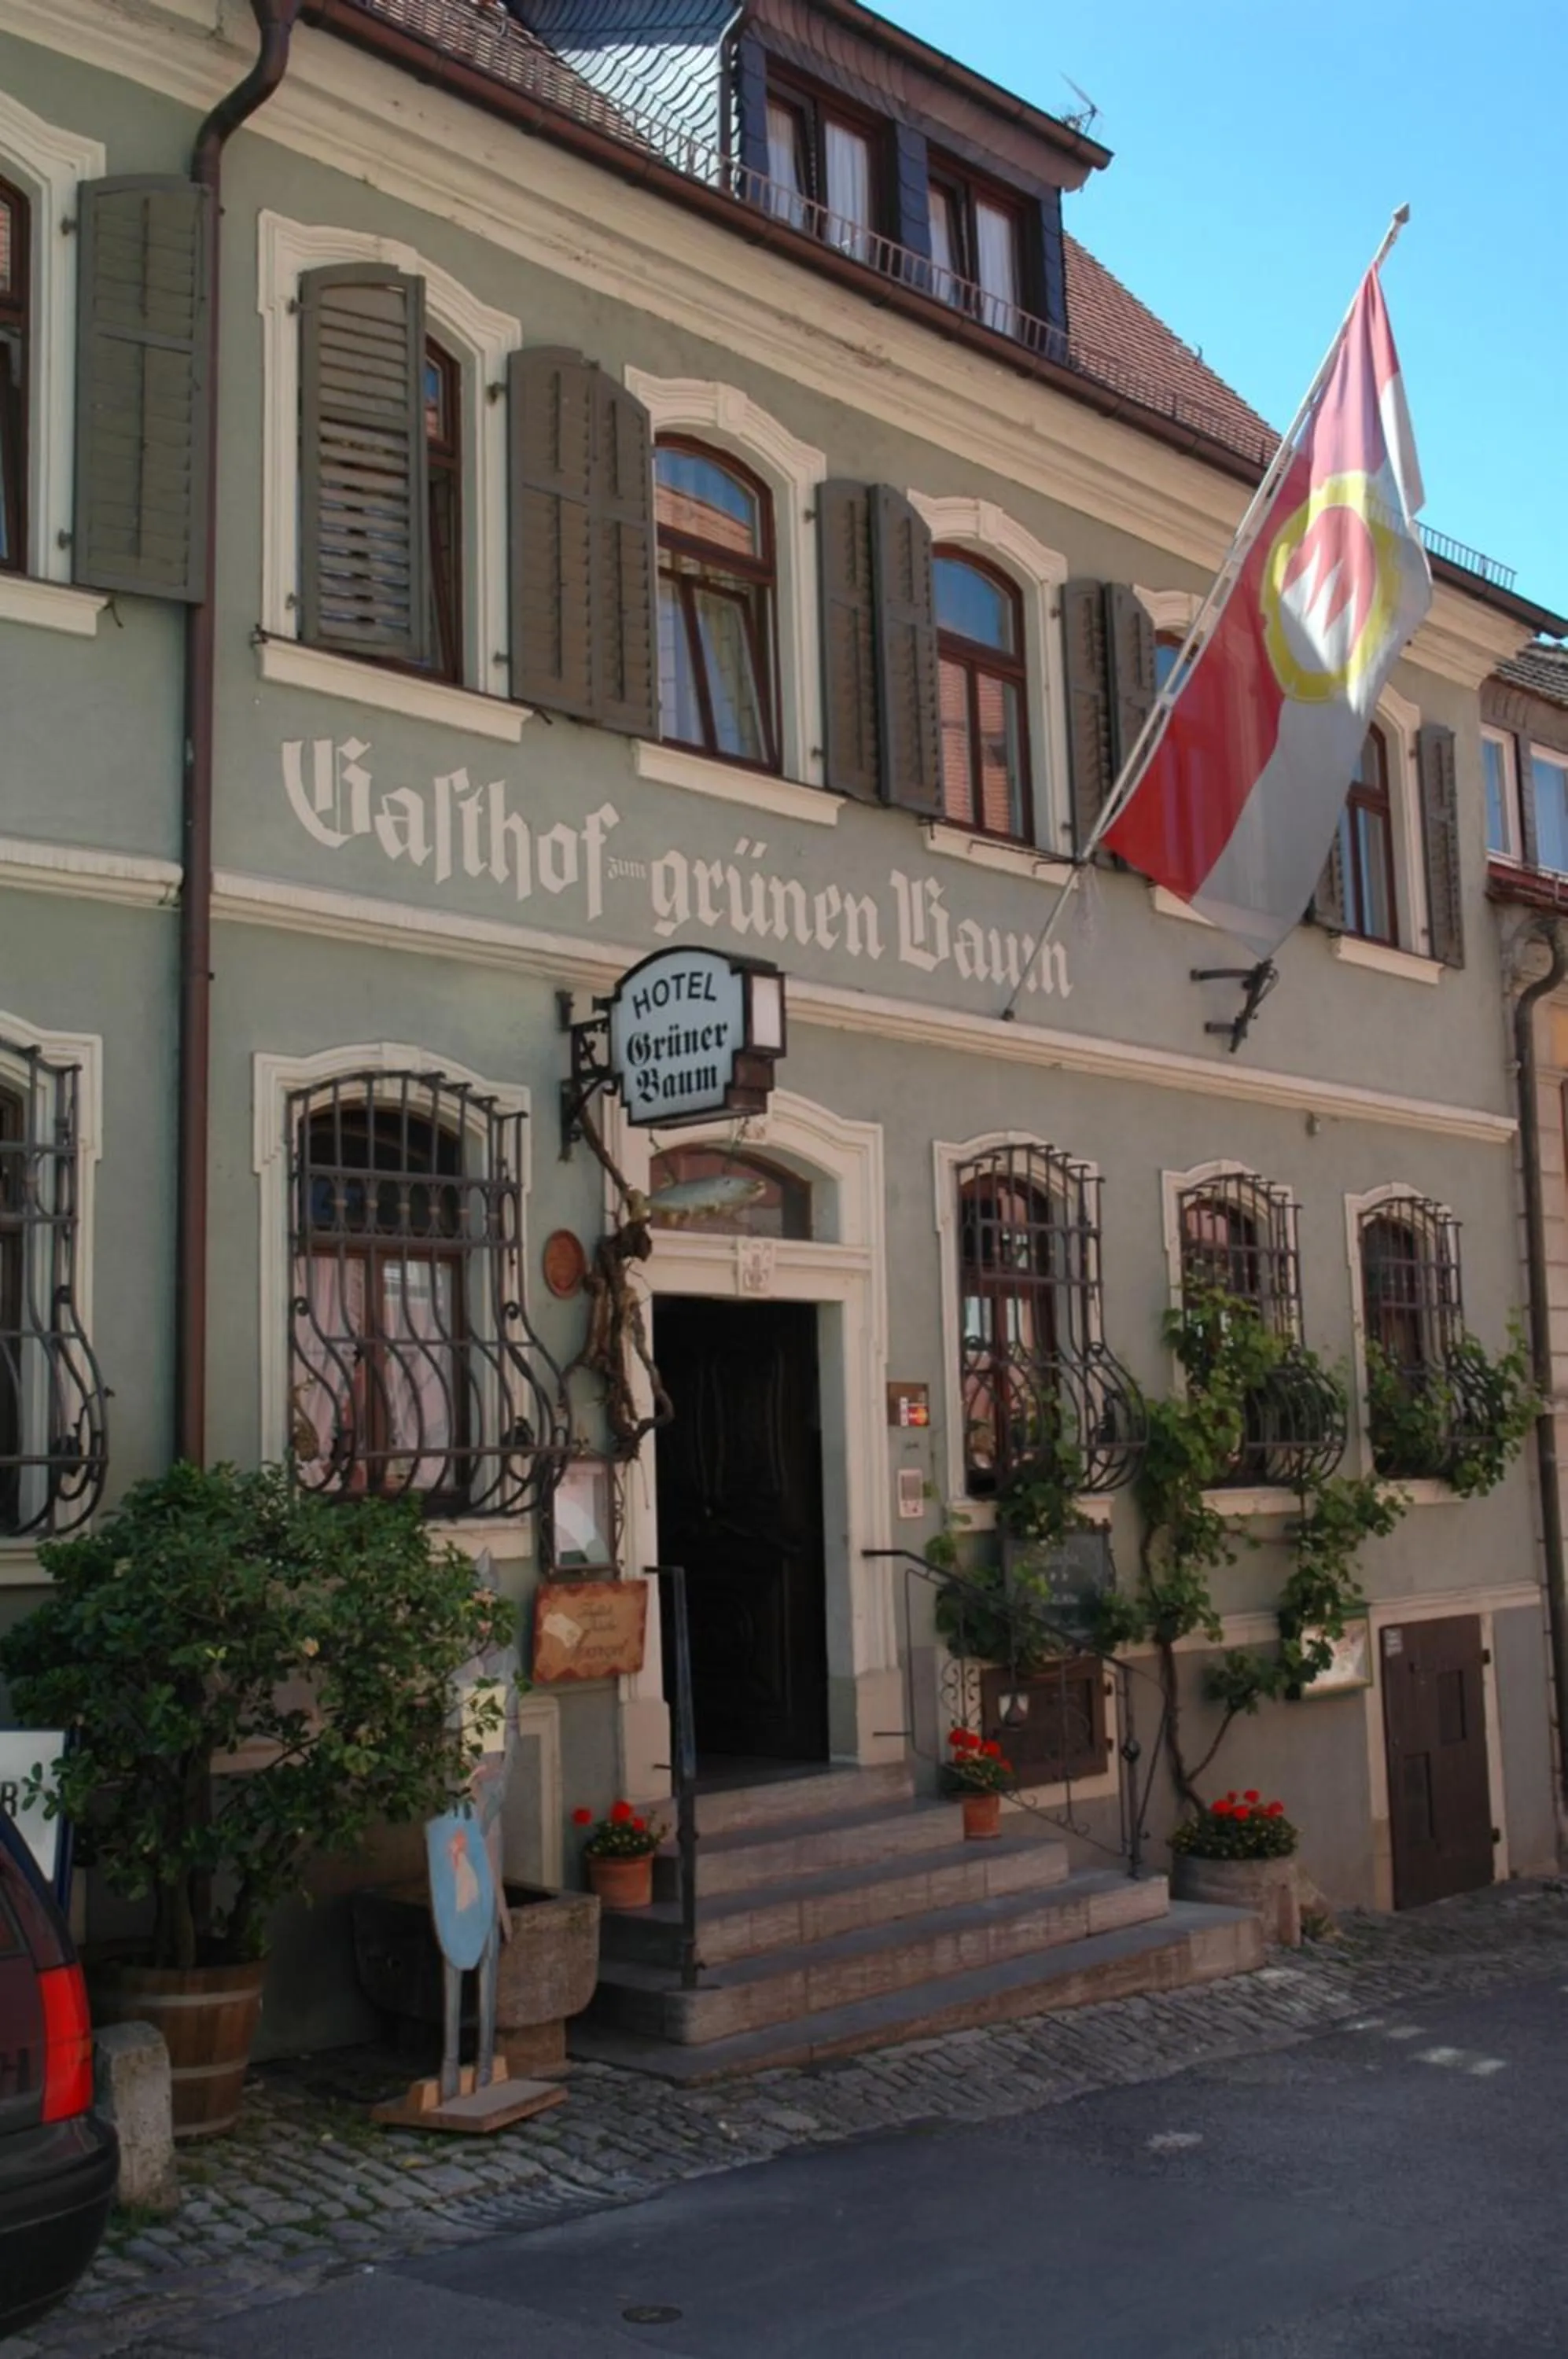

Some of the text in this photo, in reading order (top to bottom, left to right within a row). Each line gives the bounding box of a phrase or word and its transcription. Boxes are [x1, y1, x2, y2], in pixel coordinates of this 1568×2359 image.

[606, 856, 646, 880] zum
[651, 837, 885, 960] grünen
[889, 869, 1073, 999] Baum
[632, 971, 717, 1020] HOTEL
[626, 1022, 728, 1067] Grüner
[636, 1064, 718, 1102] Baum
